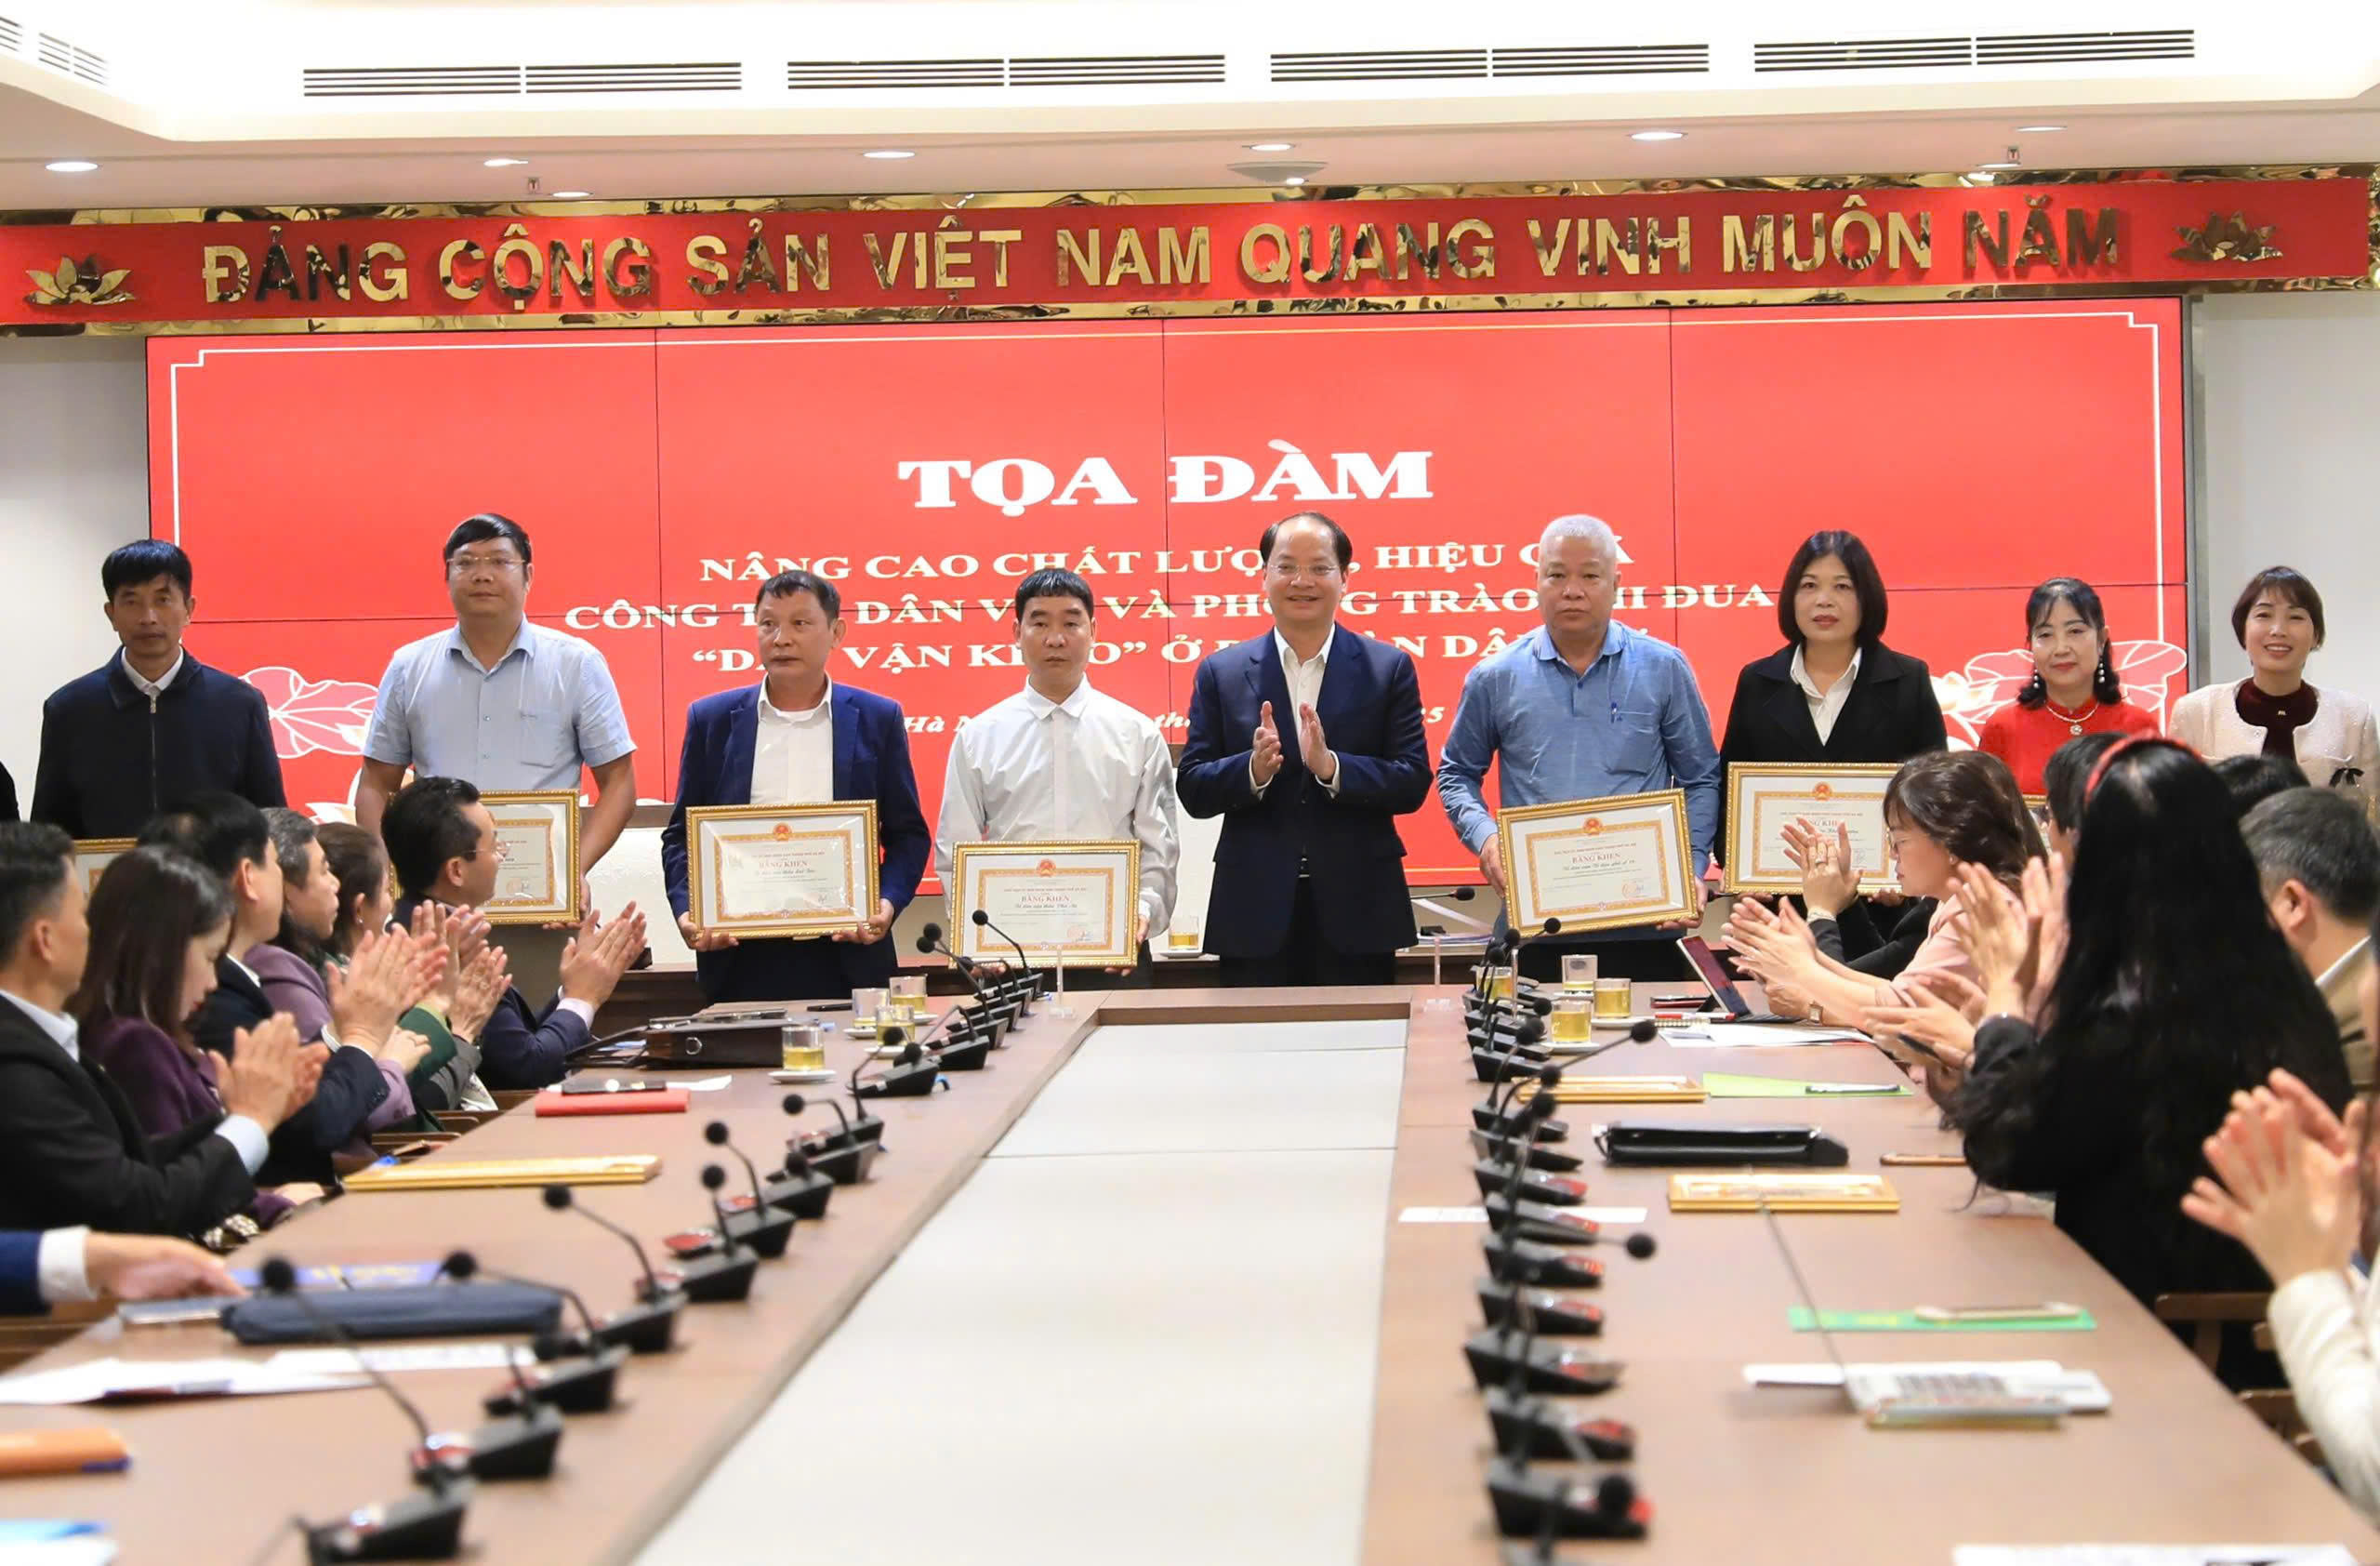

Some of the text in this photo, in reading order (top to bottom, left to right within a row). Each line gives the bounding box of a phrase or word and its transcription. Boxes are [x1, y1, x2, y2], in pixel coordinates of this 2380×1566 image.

[202, 193, 2119, 311] ĐẢNG CỘNG SẢN VIỆT NAM QUANG VINH MUÔN NĂM
[897, 438, 1434, 516] TỌA ĐÀM
[865, 554, 979, 578] CAO
[992, 545, 1142, 577] CHẤT
[1374, 541, 1505, 573] HIỆU
[564, 598, 720, 630] CÔNG
[854, 593, 965, 624] DÂN
[1102, 589, 1176, 618] VÀ
[1191, 591, 1380, 618] PHG
[1392, 582, 1540, 614] TRÀO
[1661, 583, 1775, 609] ĐUA
[841, 643, 953, 674] VẬN
[1160, 633, 1204, 663] Ở
[1442, 627, 1536, 657] DÂ
[904, 715, 945, 733] Hà
